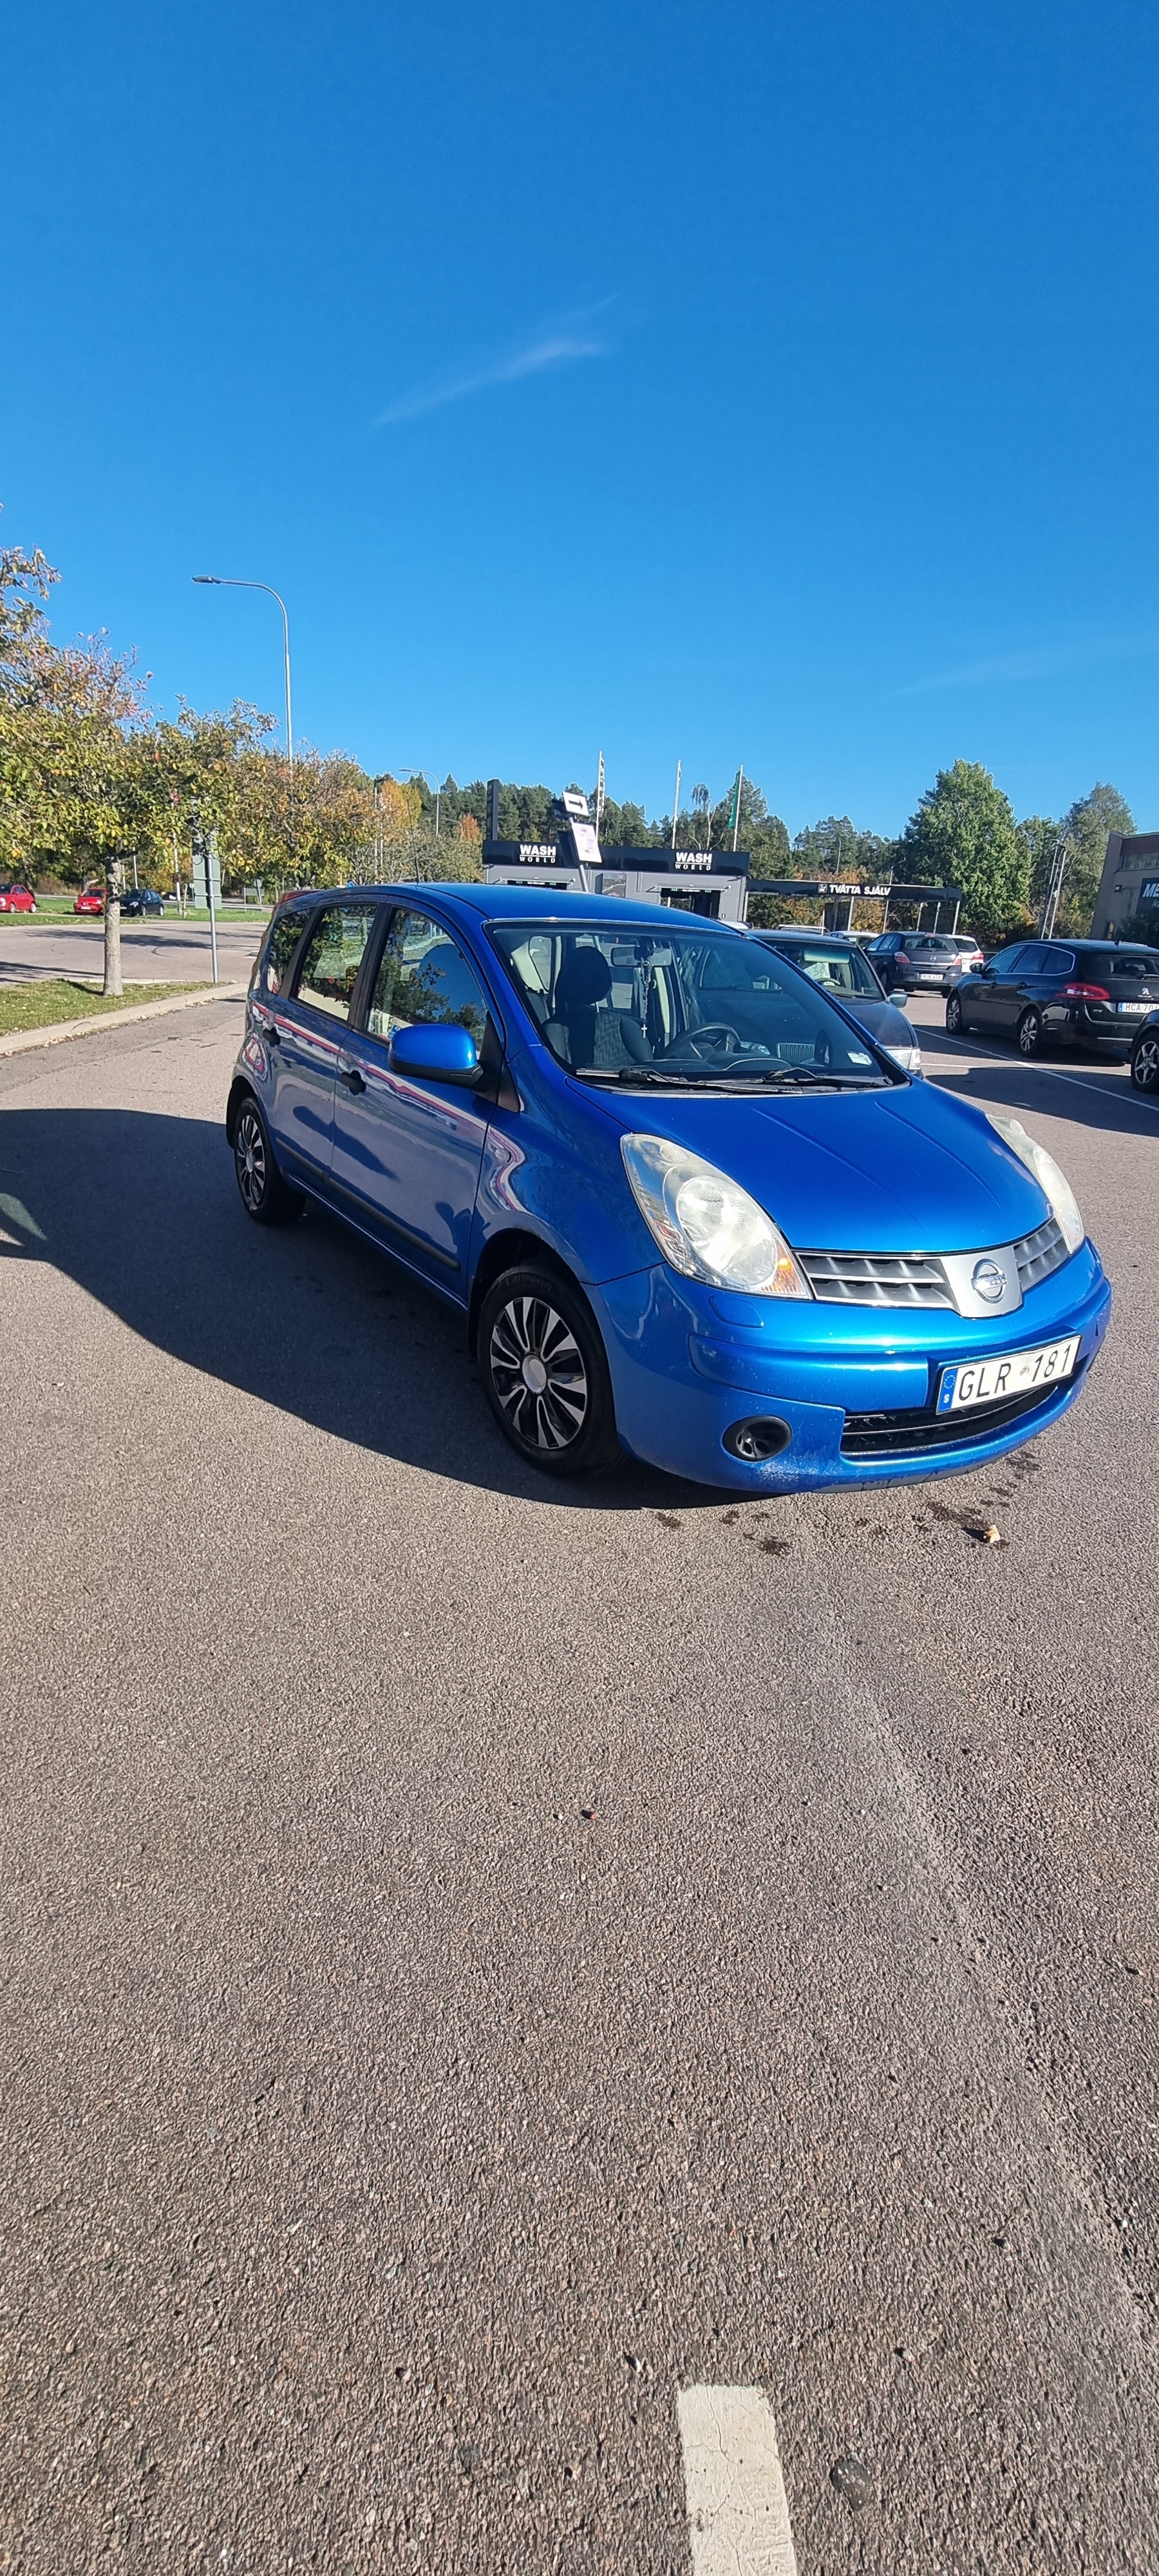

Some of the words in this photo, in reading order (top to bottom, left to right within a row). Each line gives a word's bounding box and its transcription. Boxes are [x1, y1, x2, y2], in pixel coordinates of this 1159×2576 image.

[520, 844, 556, 856] WASH
[675, 852, 712, 863] WASH
[943, 1394, 950, 1403] S
[959, 1362, 1012, 1401] GLR
[1032, 1343, 1071, 1382] 181
